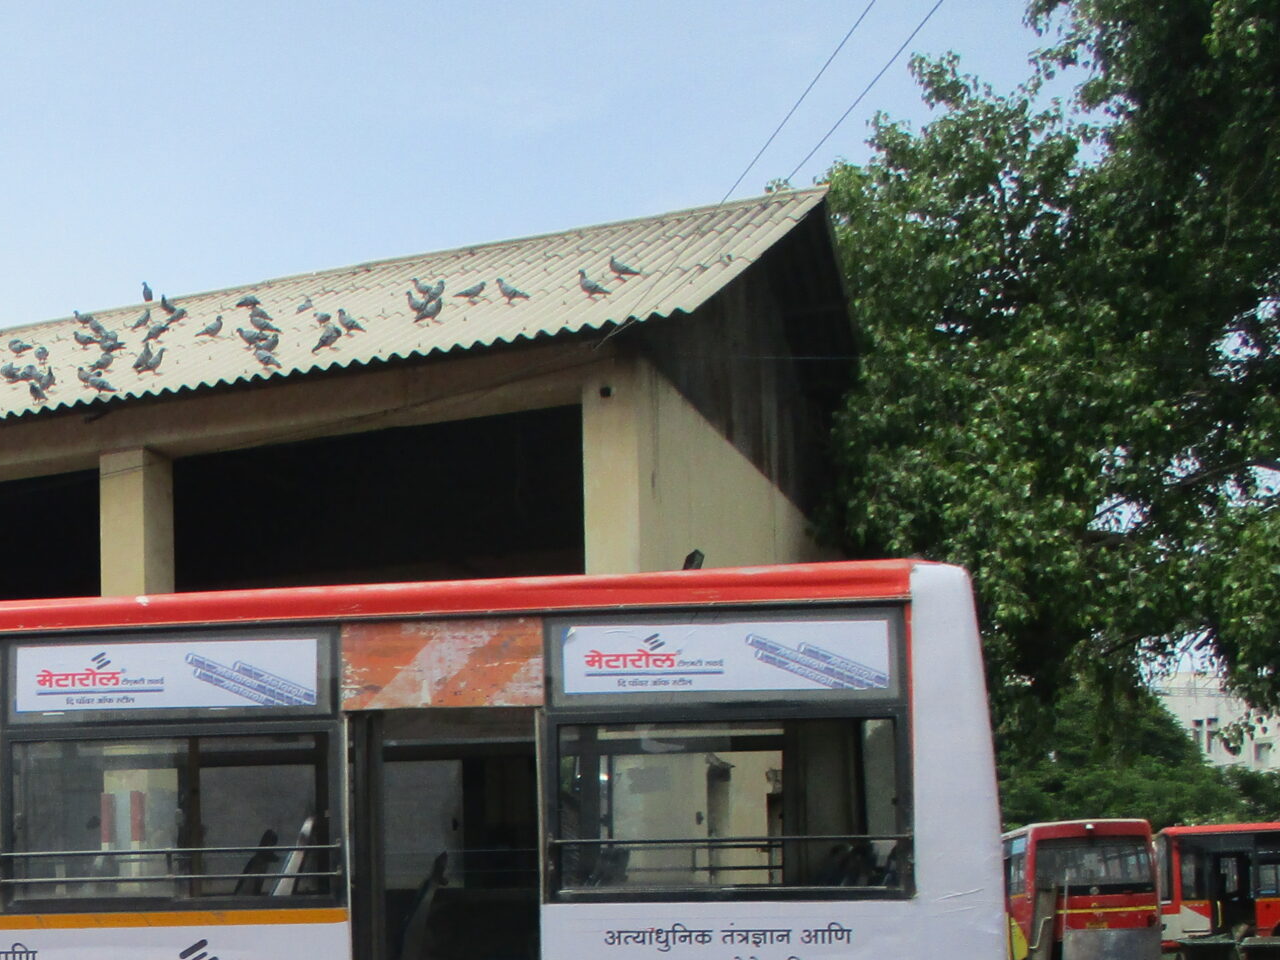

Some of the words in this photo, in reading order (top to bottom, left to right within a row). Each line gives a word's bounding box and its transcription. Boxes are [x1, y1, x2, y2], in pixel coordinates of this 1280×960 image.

[604, 923, 713, 951] अत्याधुनिक
[721, 923, 792, 947] तंत्रज्ञान
[801, 922, 853, 946] आणि
